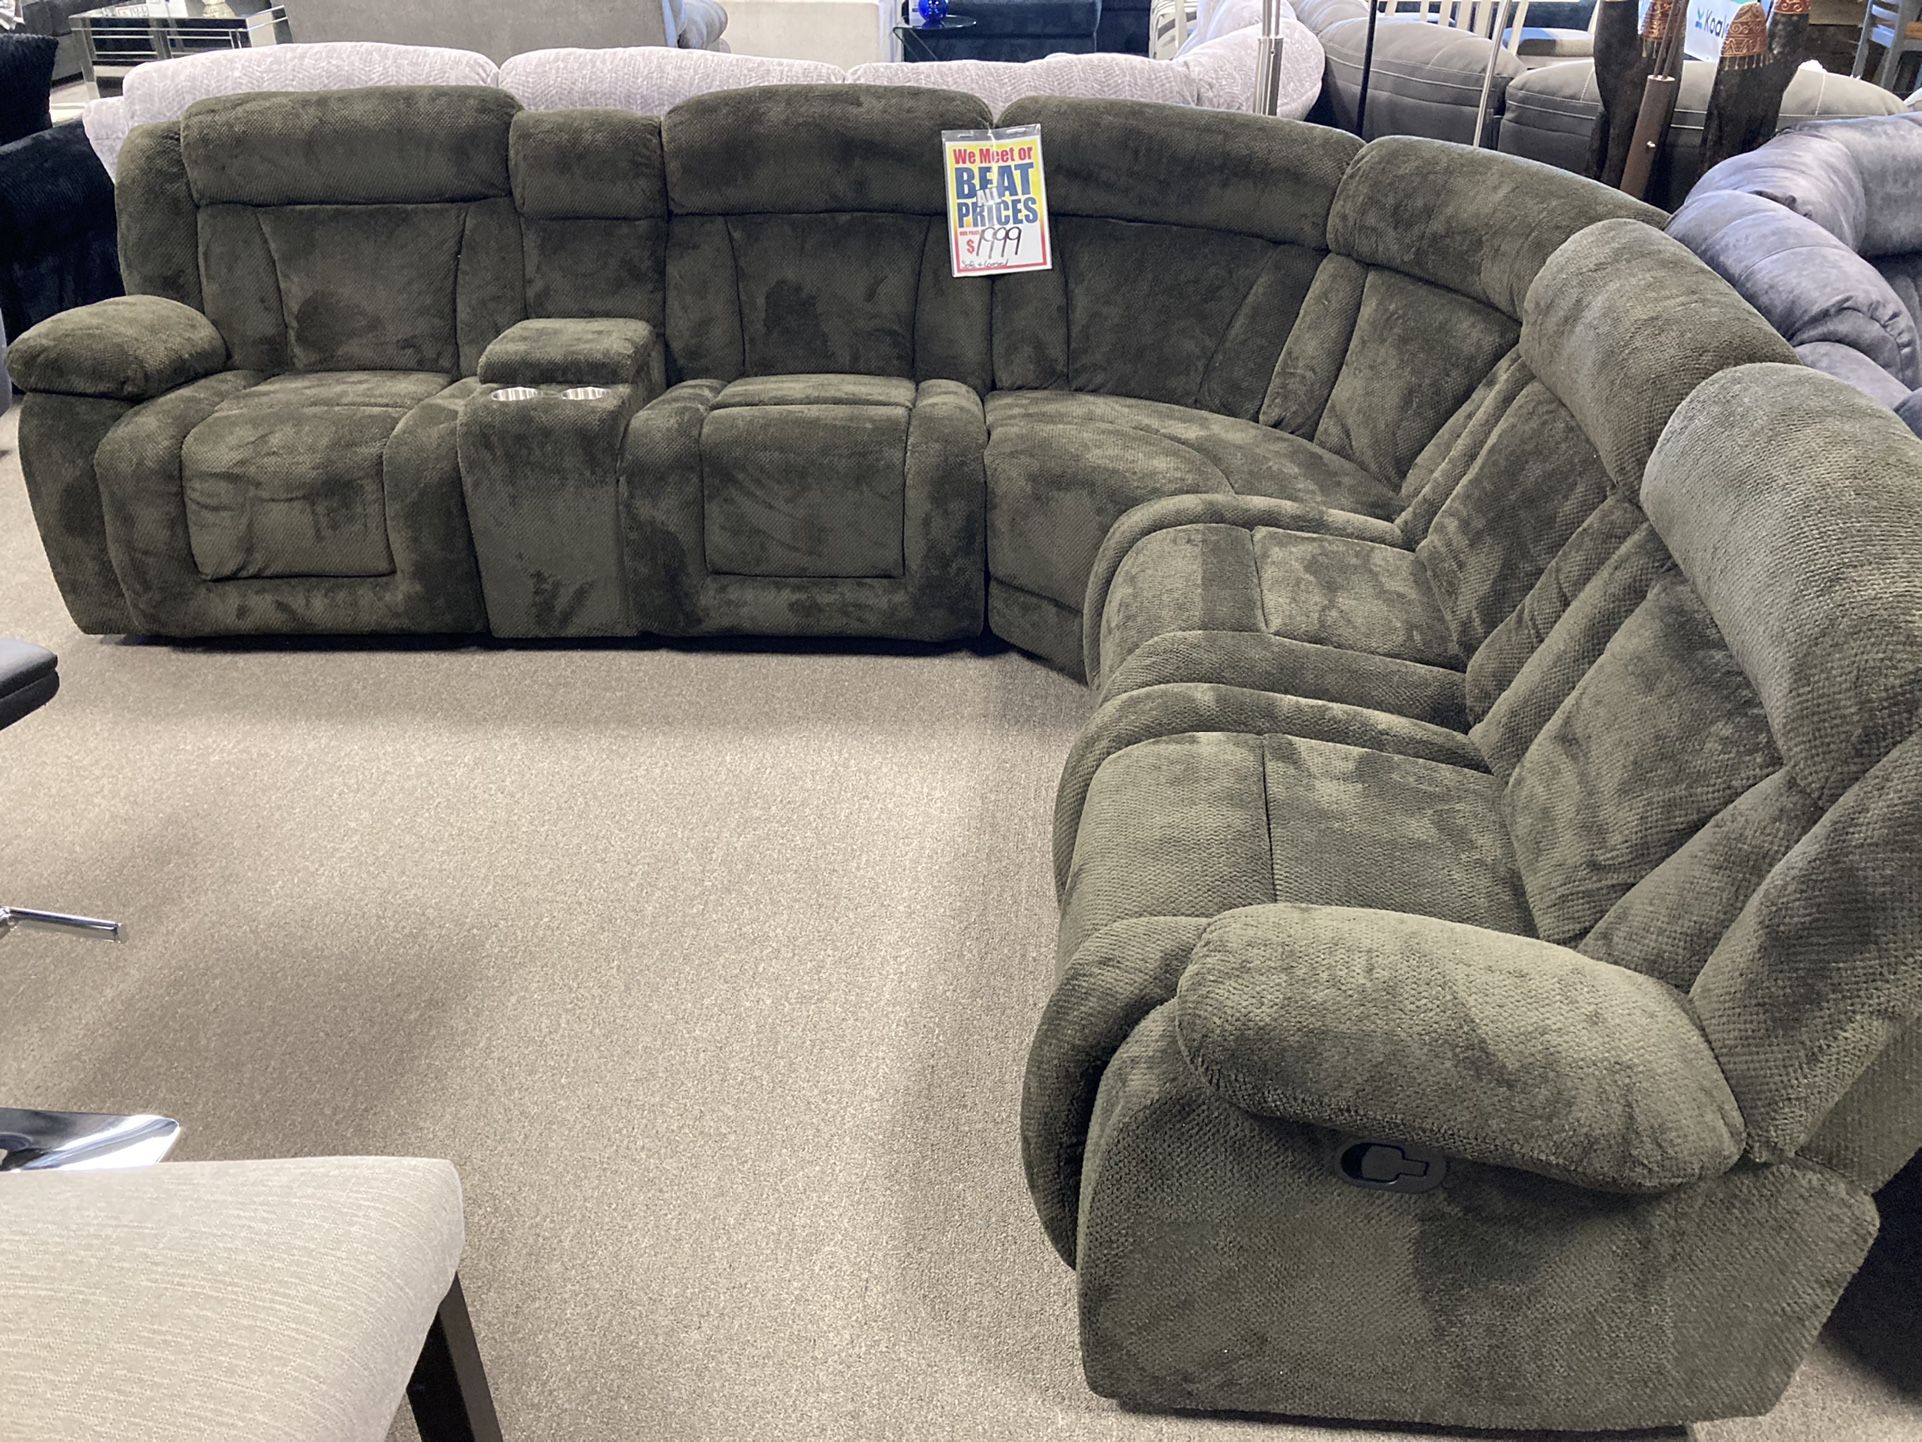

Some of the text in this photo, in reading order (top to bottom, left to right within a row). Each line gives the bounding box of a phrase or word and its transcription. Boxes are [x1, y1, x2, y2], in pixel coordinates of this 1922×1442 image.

[953, 146, 1033, 165] We Meet or
[955, 162, 1034, 200] BEAT
[976, 187, 1002, 207] ALL
[956, 196, 1039, 229] PRICES
